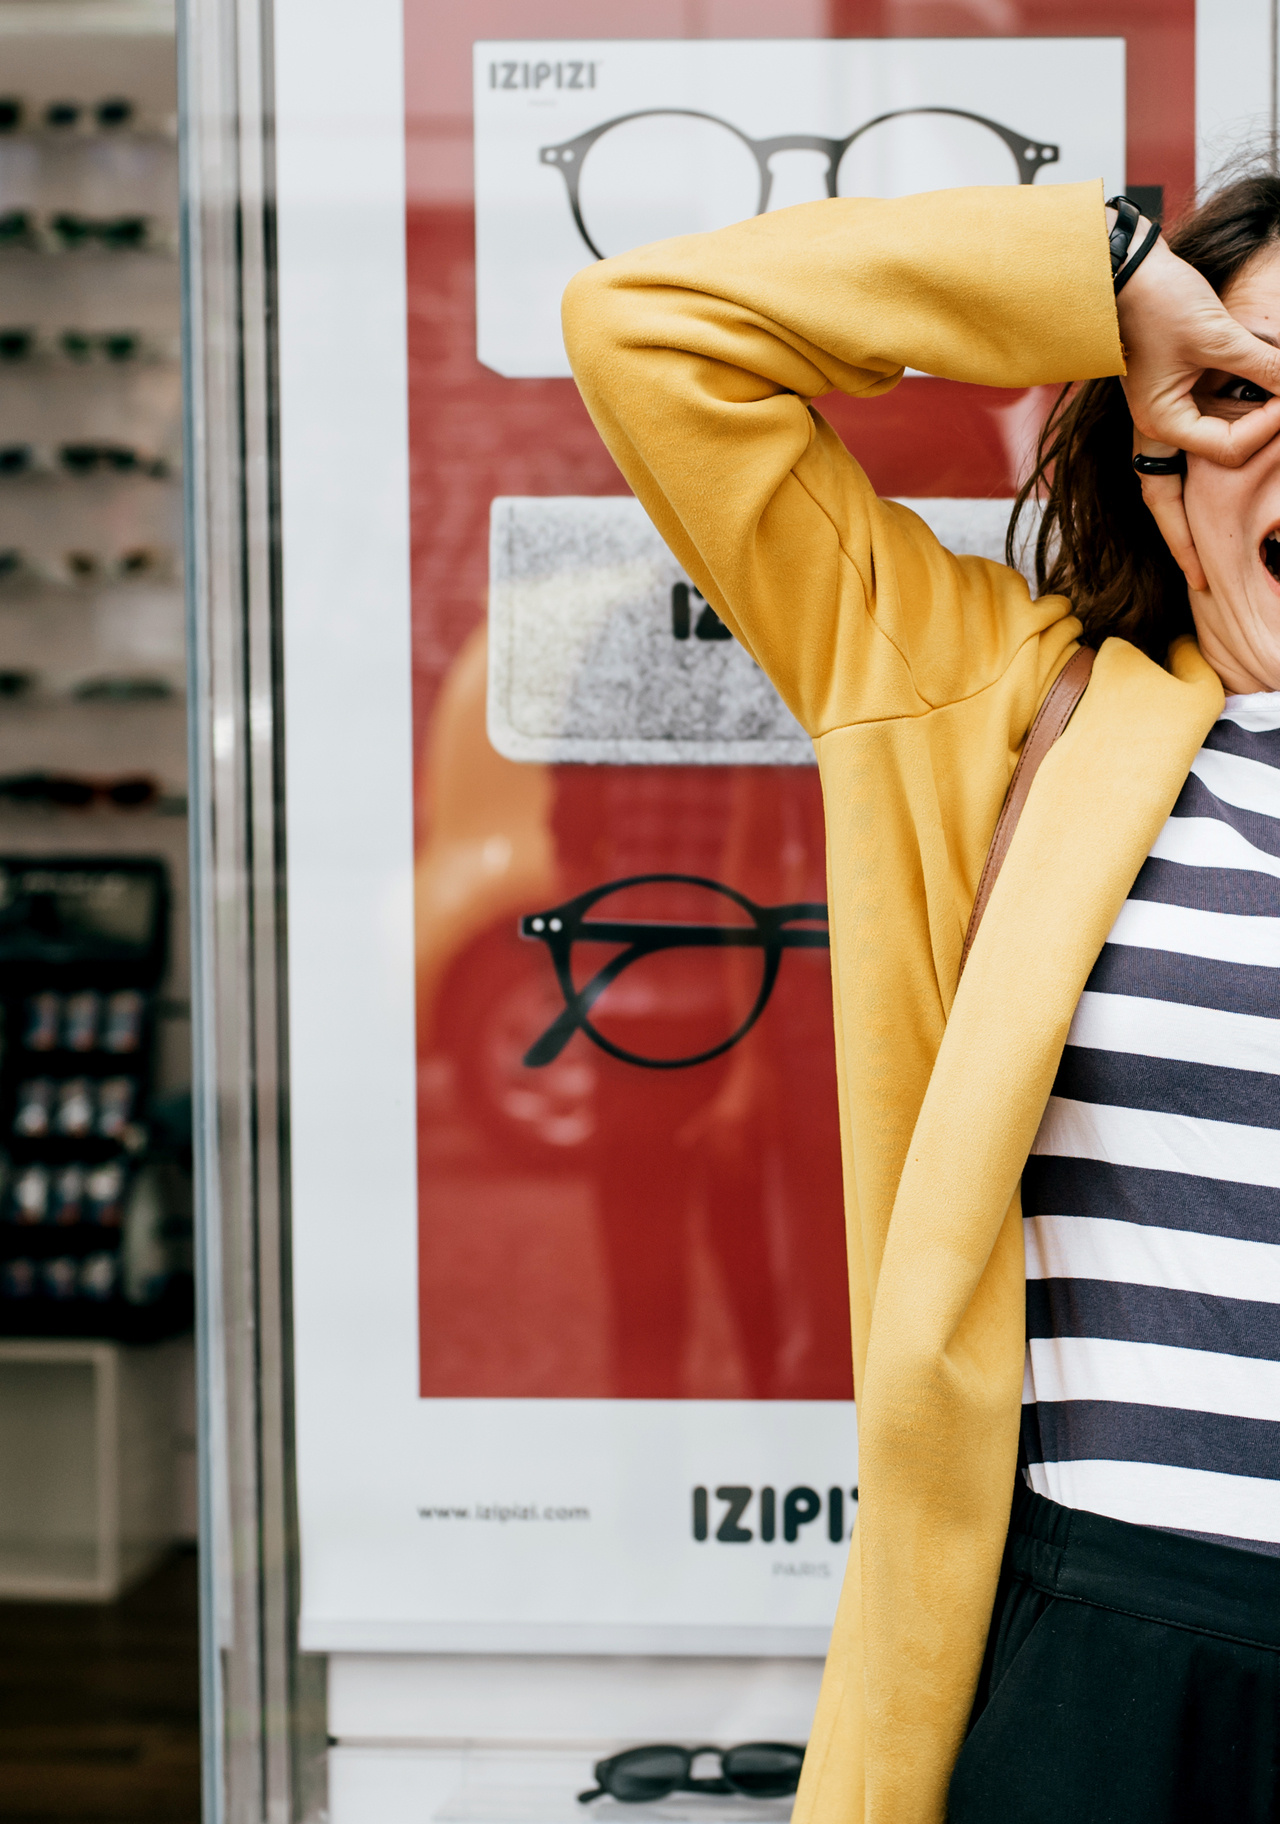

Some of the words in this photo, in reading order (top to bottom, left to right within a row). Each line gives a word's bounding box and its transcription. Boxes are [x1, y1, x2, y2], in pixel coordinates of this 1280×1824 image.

[488, 60, 597, 91] IZIPIZI
[417, 1504, 591, 1524] www.izipizi.com
[692, 1485, 859, 1543] IZIPI
[772, 1561, 831, 1579] PARIS
